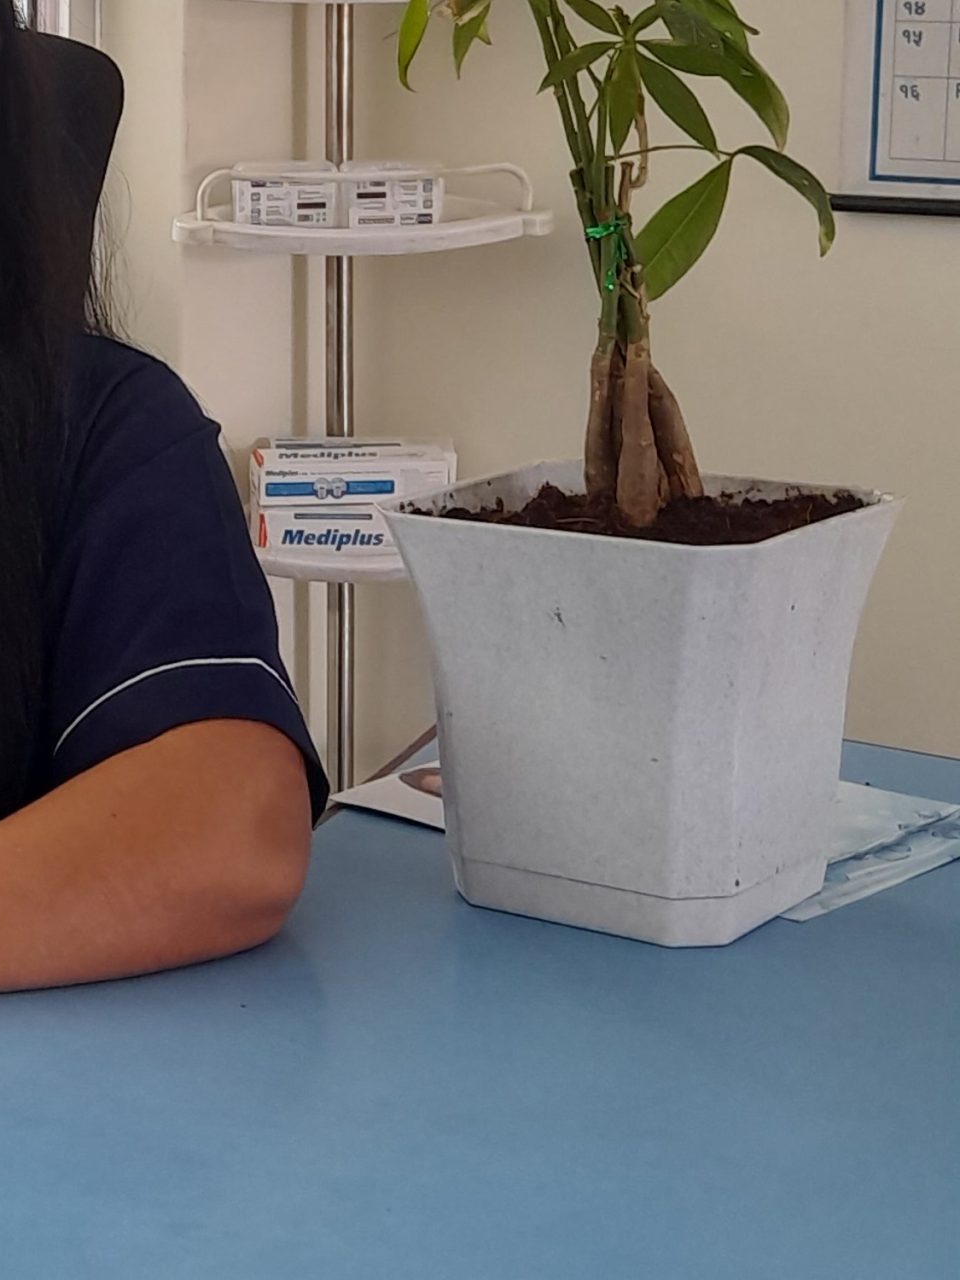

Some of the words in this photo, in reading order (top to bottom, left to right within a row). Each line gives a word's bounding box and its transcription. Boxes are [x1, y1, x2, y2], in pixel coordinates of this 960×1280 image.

[903, 1, 925, 15] १४
[902, 29, 922, 47] १५
[900, 85, 920, 101] १६
[281, 529, 385, 551] Mediplus
